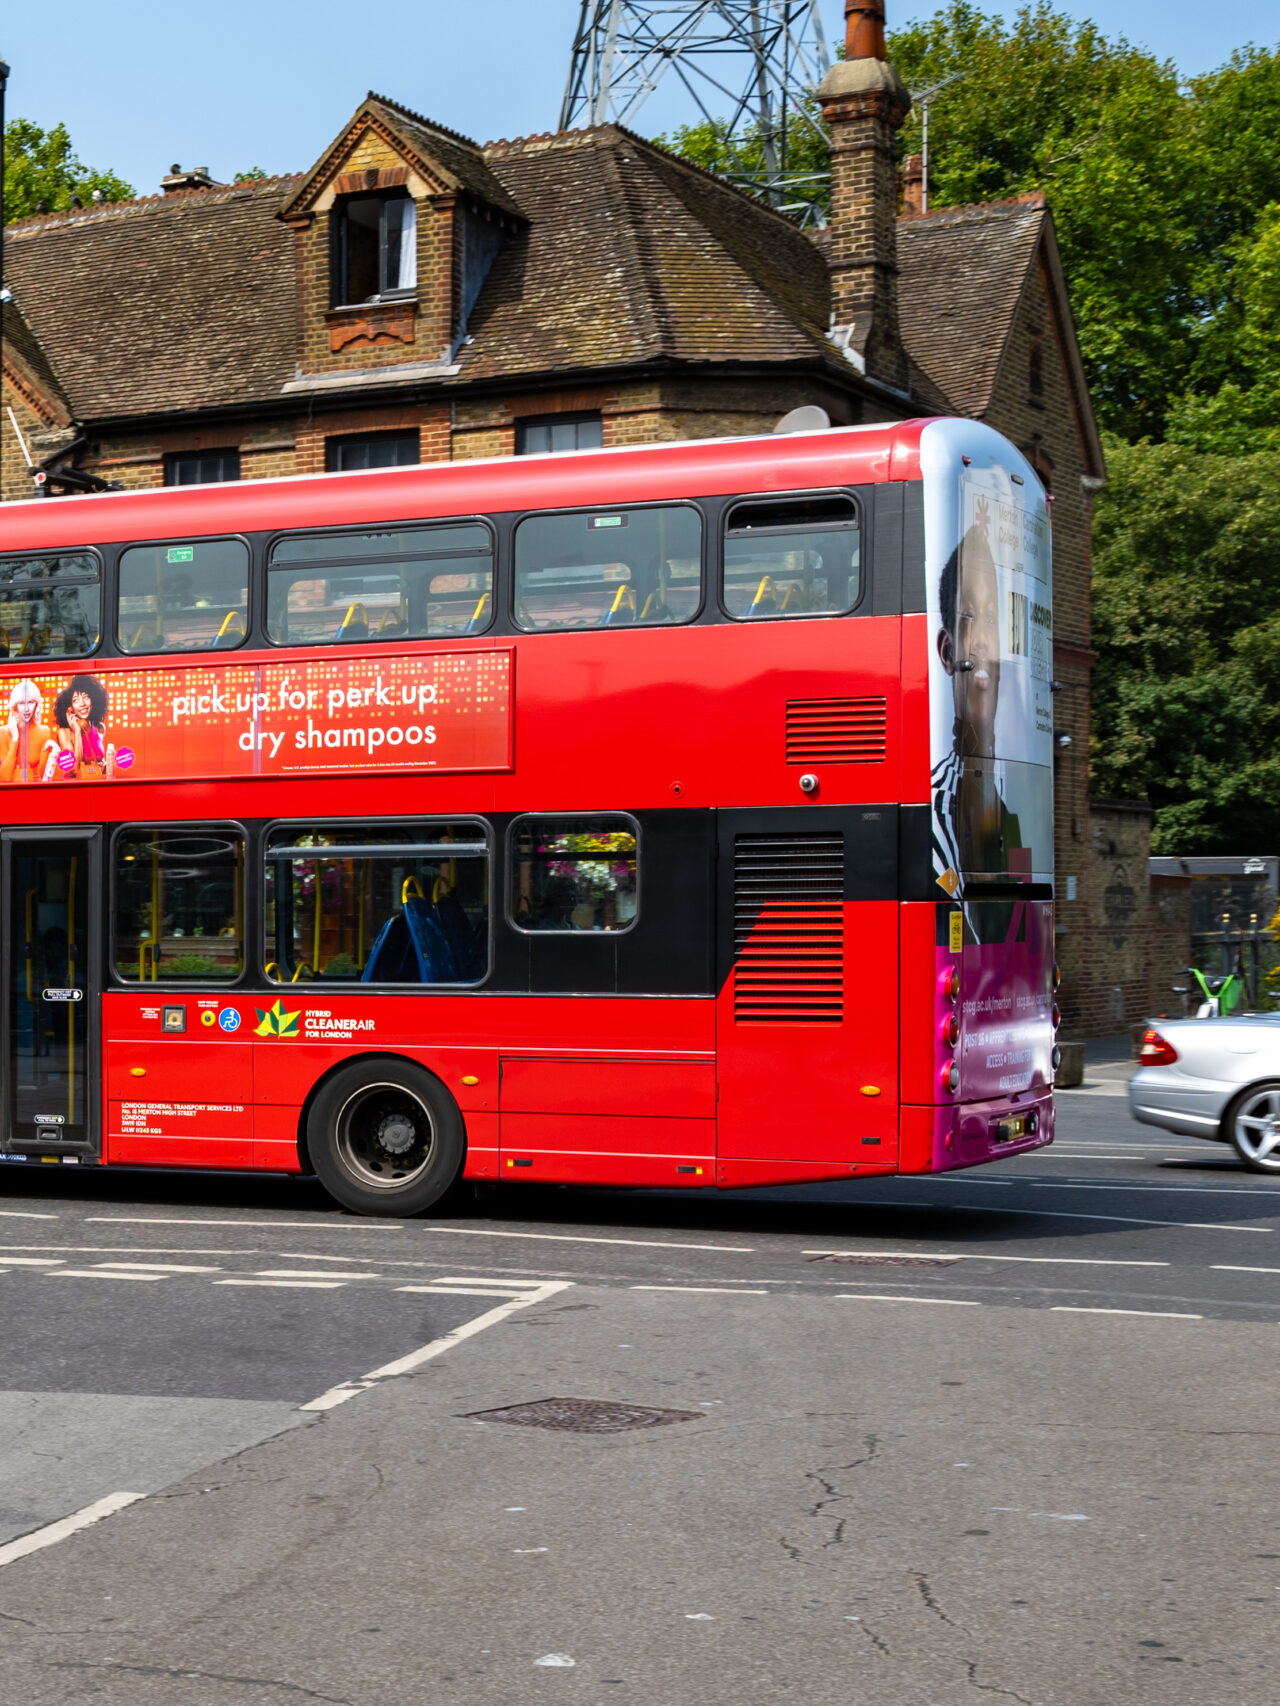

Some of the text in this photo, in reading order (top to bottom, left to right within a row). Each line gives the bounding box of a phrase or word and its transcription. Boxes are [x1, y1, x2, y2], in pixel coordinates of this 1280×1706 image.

[173, 676, 437, 723] pick up for perk up
[238, 719, 437, 758] dry shampoos
[305, 1010, 332, 1018] HYBRID
[304, 1018, 376, 1031] CLEANERAIR
[305, 1030, 352, 1039] FOR LONDON
